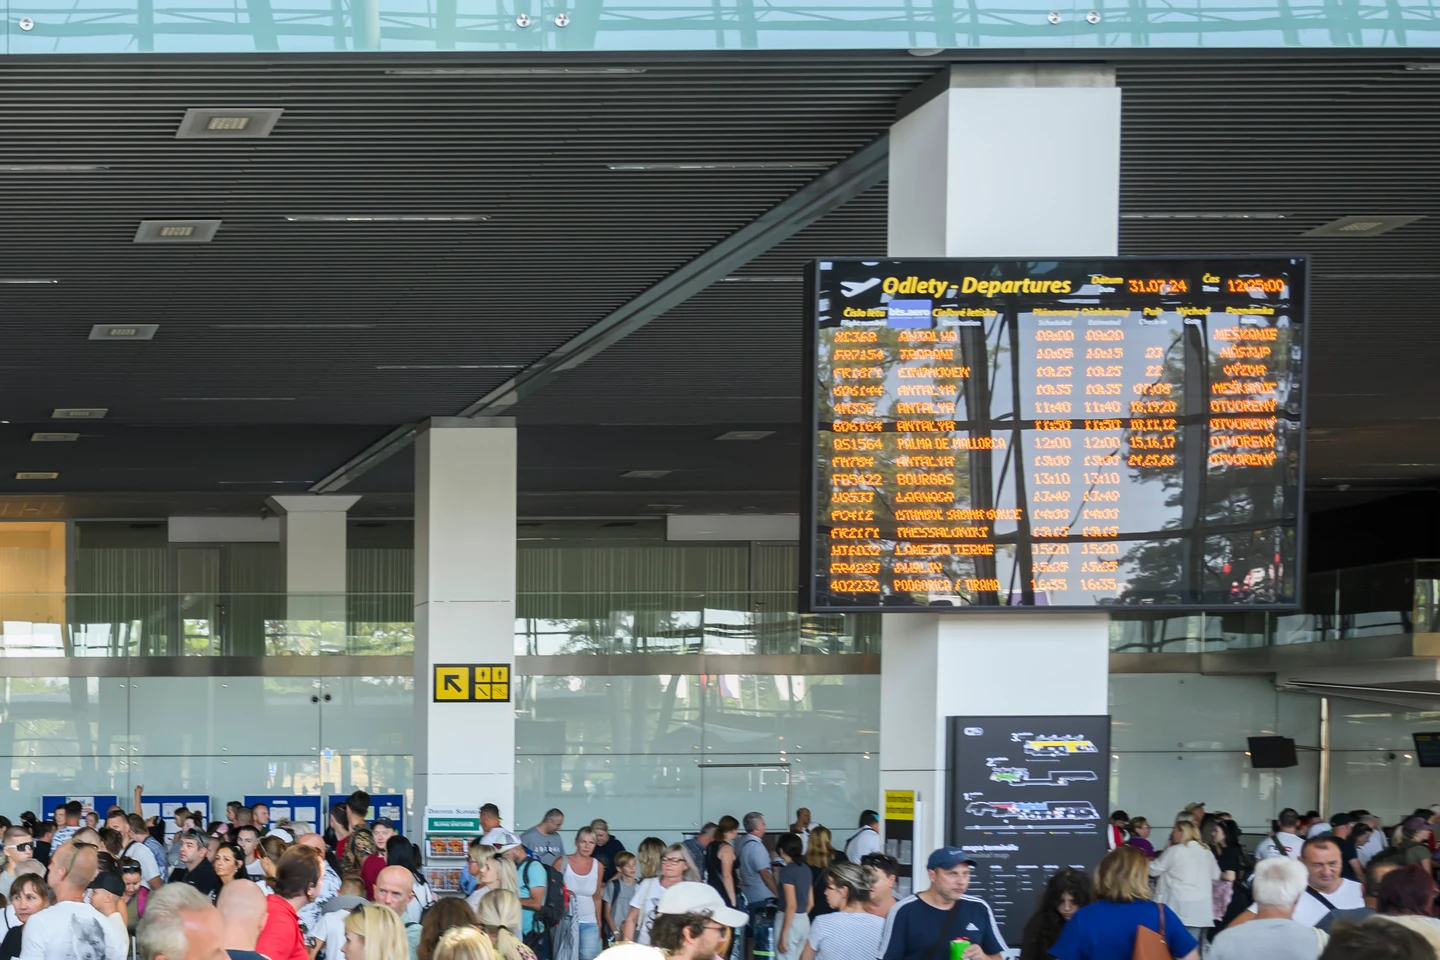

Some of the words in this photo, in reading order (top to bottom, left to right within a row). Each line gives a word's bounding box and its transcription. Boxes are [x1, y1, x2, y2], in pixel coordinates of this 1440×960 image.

[1202, 273, 1220, 284] Čas
[882, 276, 948, 298] Odlety
[962, 276, 1072, 298] Departures
[1128, 279, 1187, 293] 31.07.24
[1227, 279, 1285, 293] 12:25:00
[889, 308, 930, 317] bts.aero
[1213, 326, 1278, 341] MEŠKANIE
[1036, 366, 1074, 378] 10:25
[1086, 366, 1123, 378] 10:25
[897, 384, 957, 396] ANTALYA
[1212, 380, 1277, 395] MEŠKANIE
[896, 402, 956, 414] ANTALYA
[1035, 401, 1072, 413] 11:40
[1084, 401, 1122, 413] 11:40
[1210, 398, 1278, 413] OTVORENÝ
[896, 420, 956, 432] ANTALYA
[1035, 419, 1072, 431] 11:50
[1084, 419, 1122, 431] 11:50
[1209, 416, 1278, 431] OTVORENÝ
[833, 438, 883, 450] QS1564
[897, 438, 933, 450] PALMA
[935, 438, 950, 450] DE
[952, 438, 1006, 449] MALLORCA
[1034, 437, 1071, 449] 12:00
[1084, 437, 1121, 449] 12:00
[1129, 436, 1177, 450] 15,16,17
[1209, 433, 1277, 449] OTVORENÝ
[896, 456, 955, 467] ANTALYA
[1208, 451, 1277, 467] OTVORENÝ
[832, 474, 883, 486] FB5422
[896, 473, 955, 485] BOURGAS
[1034, 472, 1071, 485] 13:10
[1083, 472, 1120, 485] 13:10
[896, 527, 989, 538] THESSALONIKI
[894, 544, 951, 556] LAMEZIA
[954, 544, 994, 555] TERME
[893, 579, 951, 592] PODGORICA
[965, 579, 1001, 591] TIRANA
[1031, 579, 1068, 590] 16:35
[1080, 579, 1117, 590] 16:35
